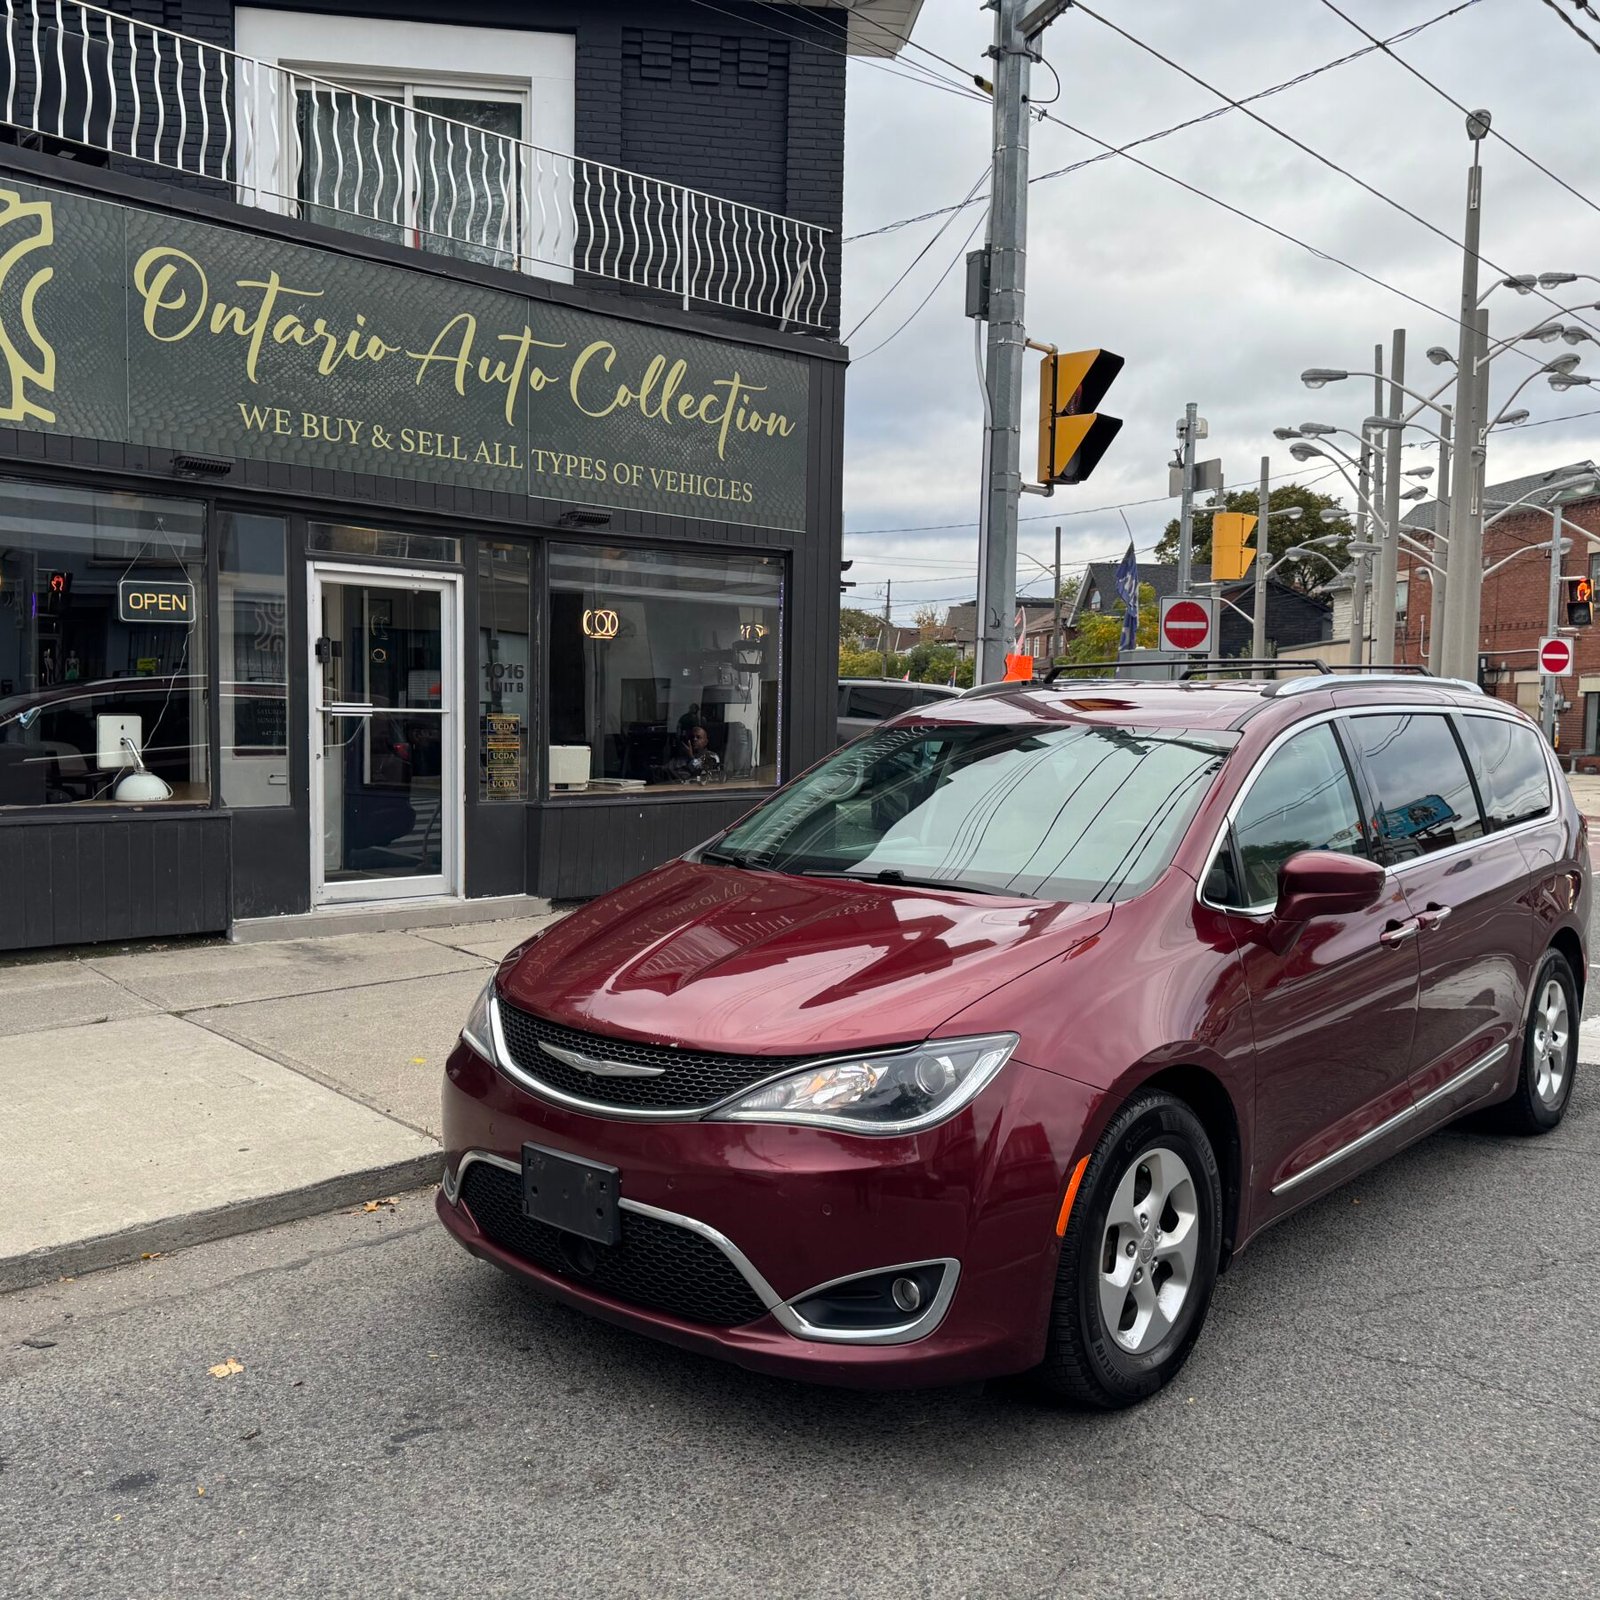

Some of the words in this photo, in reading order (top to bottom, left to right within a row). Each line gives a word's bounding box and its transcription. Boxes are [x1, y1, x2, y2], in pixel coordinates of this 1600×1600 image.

[134, 246, 401, 384] Ontario
[405, 312, 567, 427] Auto
[570, 340, 796, 461] Collection
[237, 402, 293, 435] WE
[301, 412, 364, 445] BUY
[371, 424, 394, 450] &
[400, 428, 468, 461] SELL
[473, 440, 524, 469] ALL
[531, 448, 608, 482] TYPES
[613, 462, 645, 487] OF
[650, 467, 754, 503] VEHICLES
[128, 592, 187, 611] OPEN
[481, 663, 525, 680] 1016
[492, 723, 515, 731] UCDA
[492, 752, 515, 760] UCDA
[492, 780, 515, 788] UCDA
